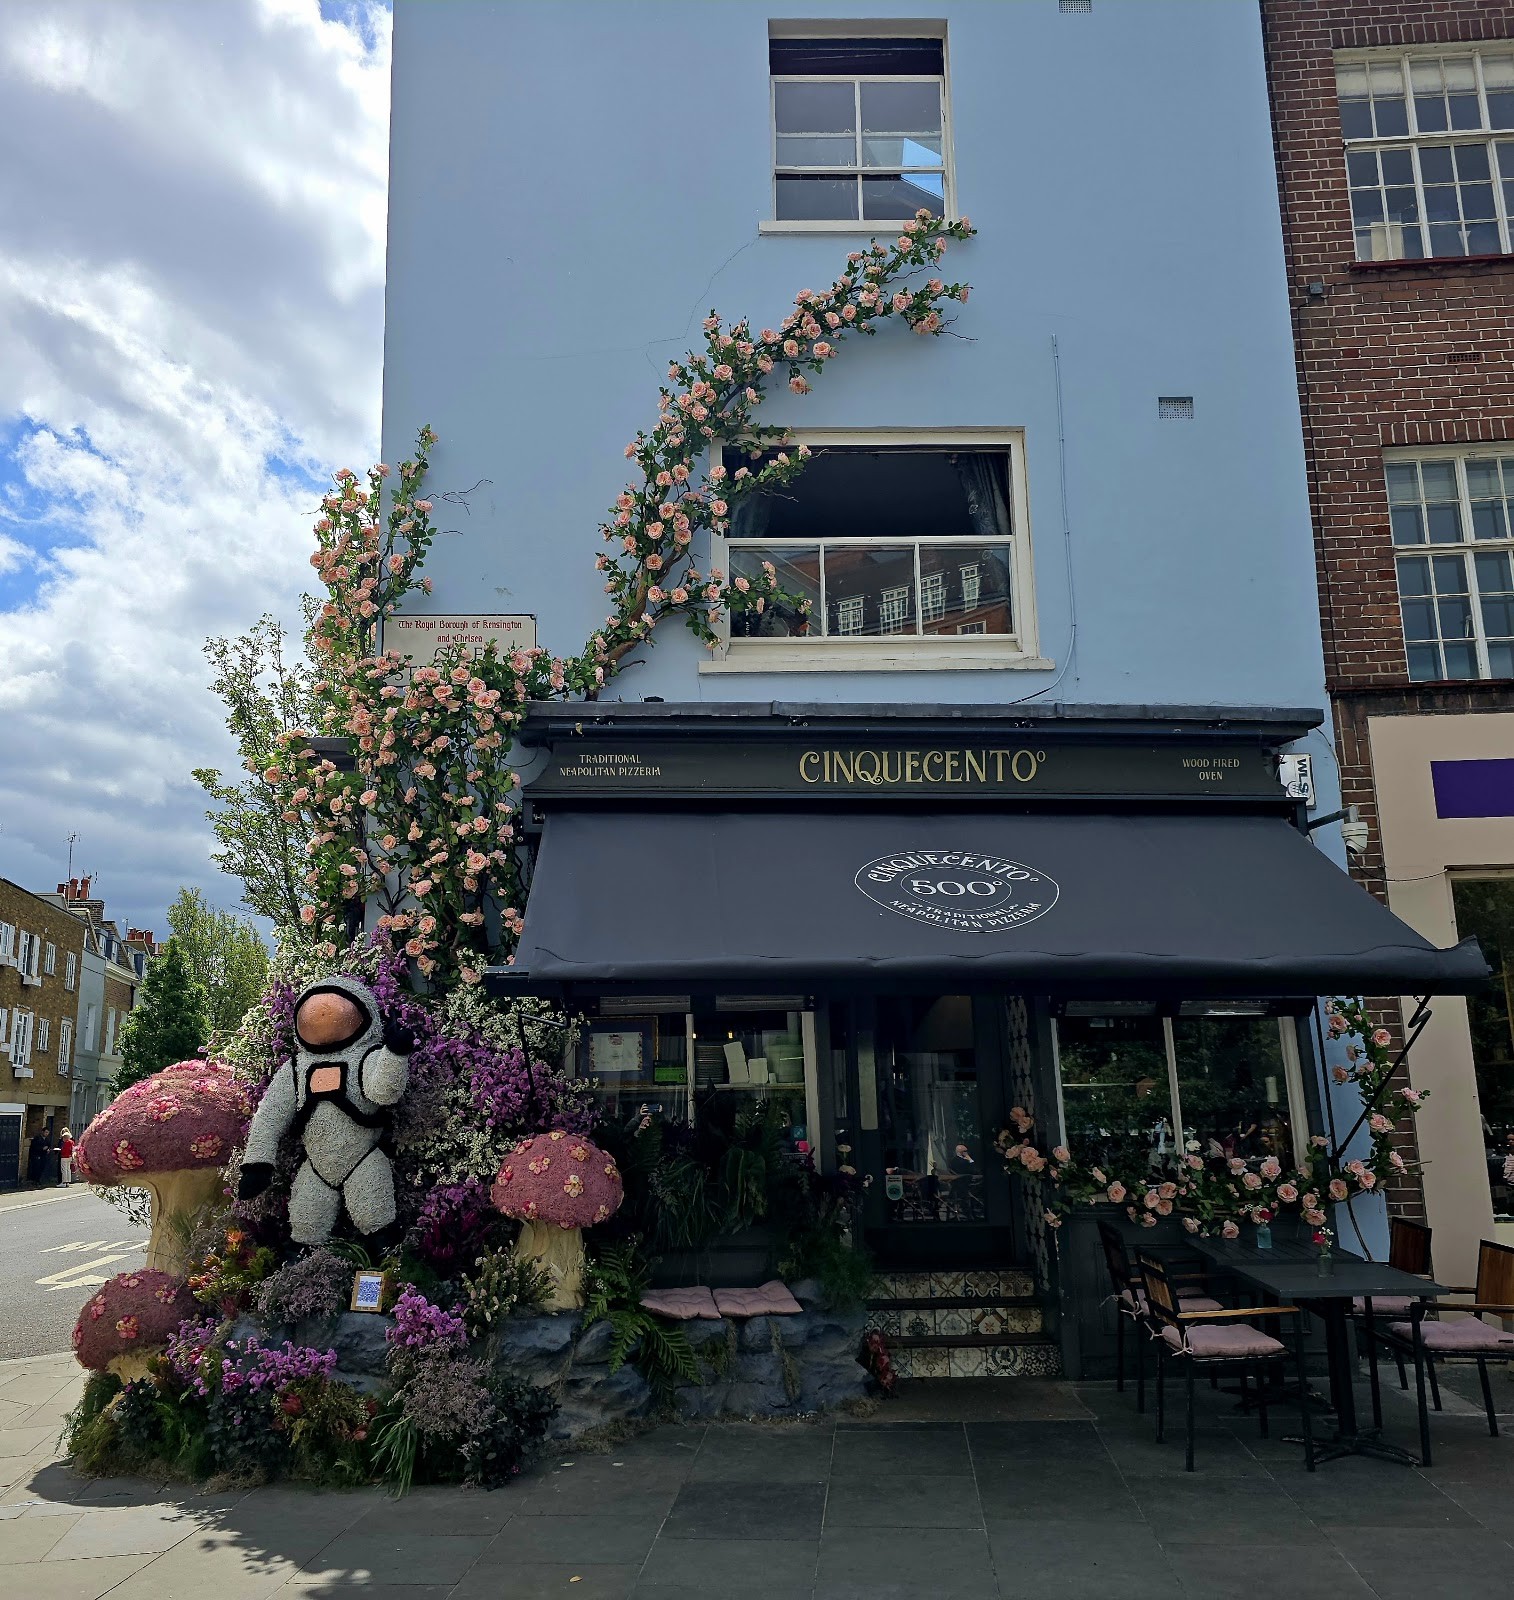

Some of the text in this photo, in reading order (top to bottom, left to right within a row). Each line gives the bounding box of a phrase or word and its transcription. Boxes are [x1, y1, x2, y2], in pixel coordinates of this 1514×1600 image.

[398, 619, 522, 632] The Royal Borough of Kensington
[437, 633, 483, 643] and Chelsea
[579, 754, 642, 764] TRADITIONAL
[1182, 758, 1240, 768] WOOD FIRED
[559, 766, 661, 776] NEAPOLITAN PIZZERIA
[1198, 771, 1223, 781] OVEN
[889, 900, 1042, 928] NEAPOLITAN PIZZERIA
[926, 906, 1012, 920] TRADITIONAL
